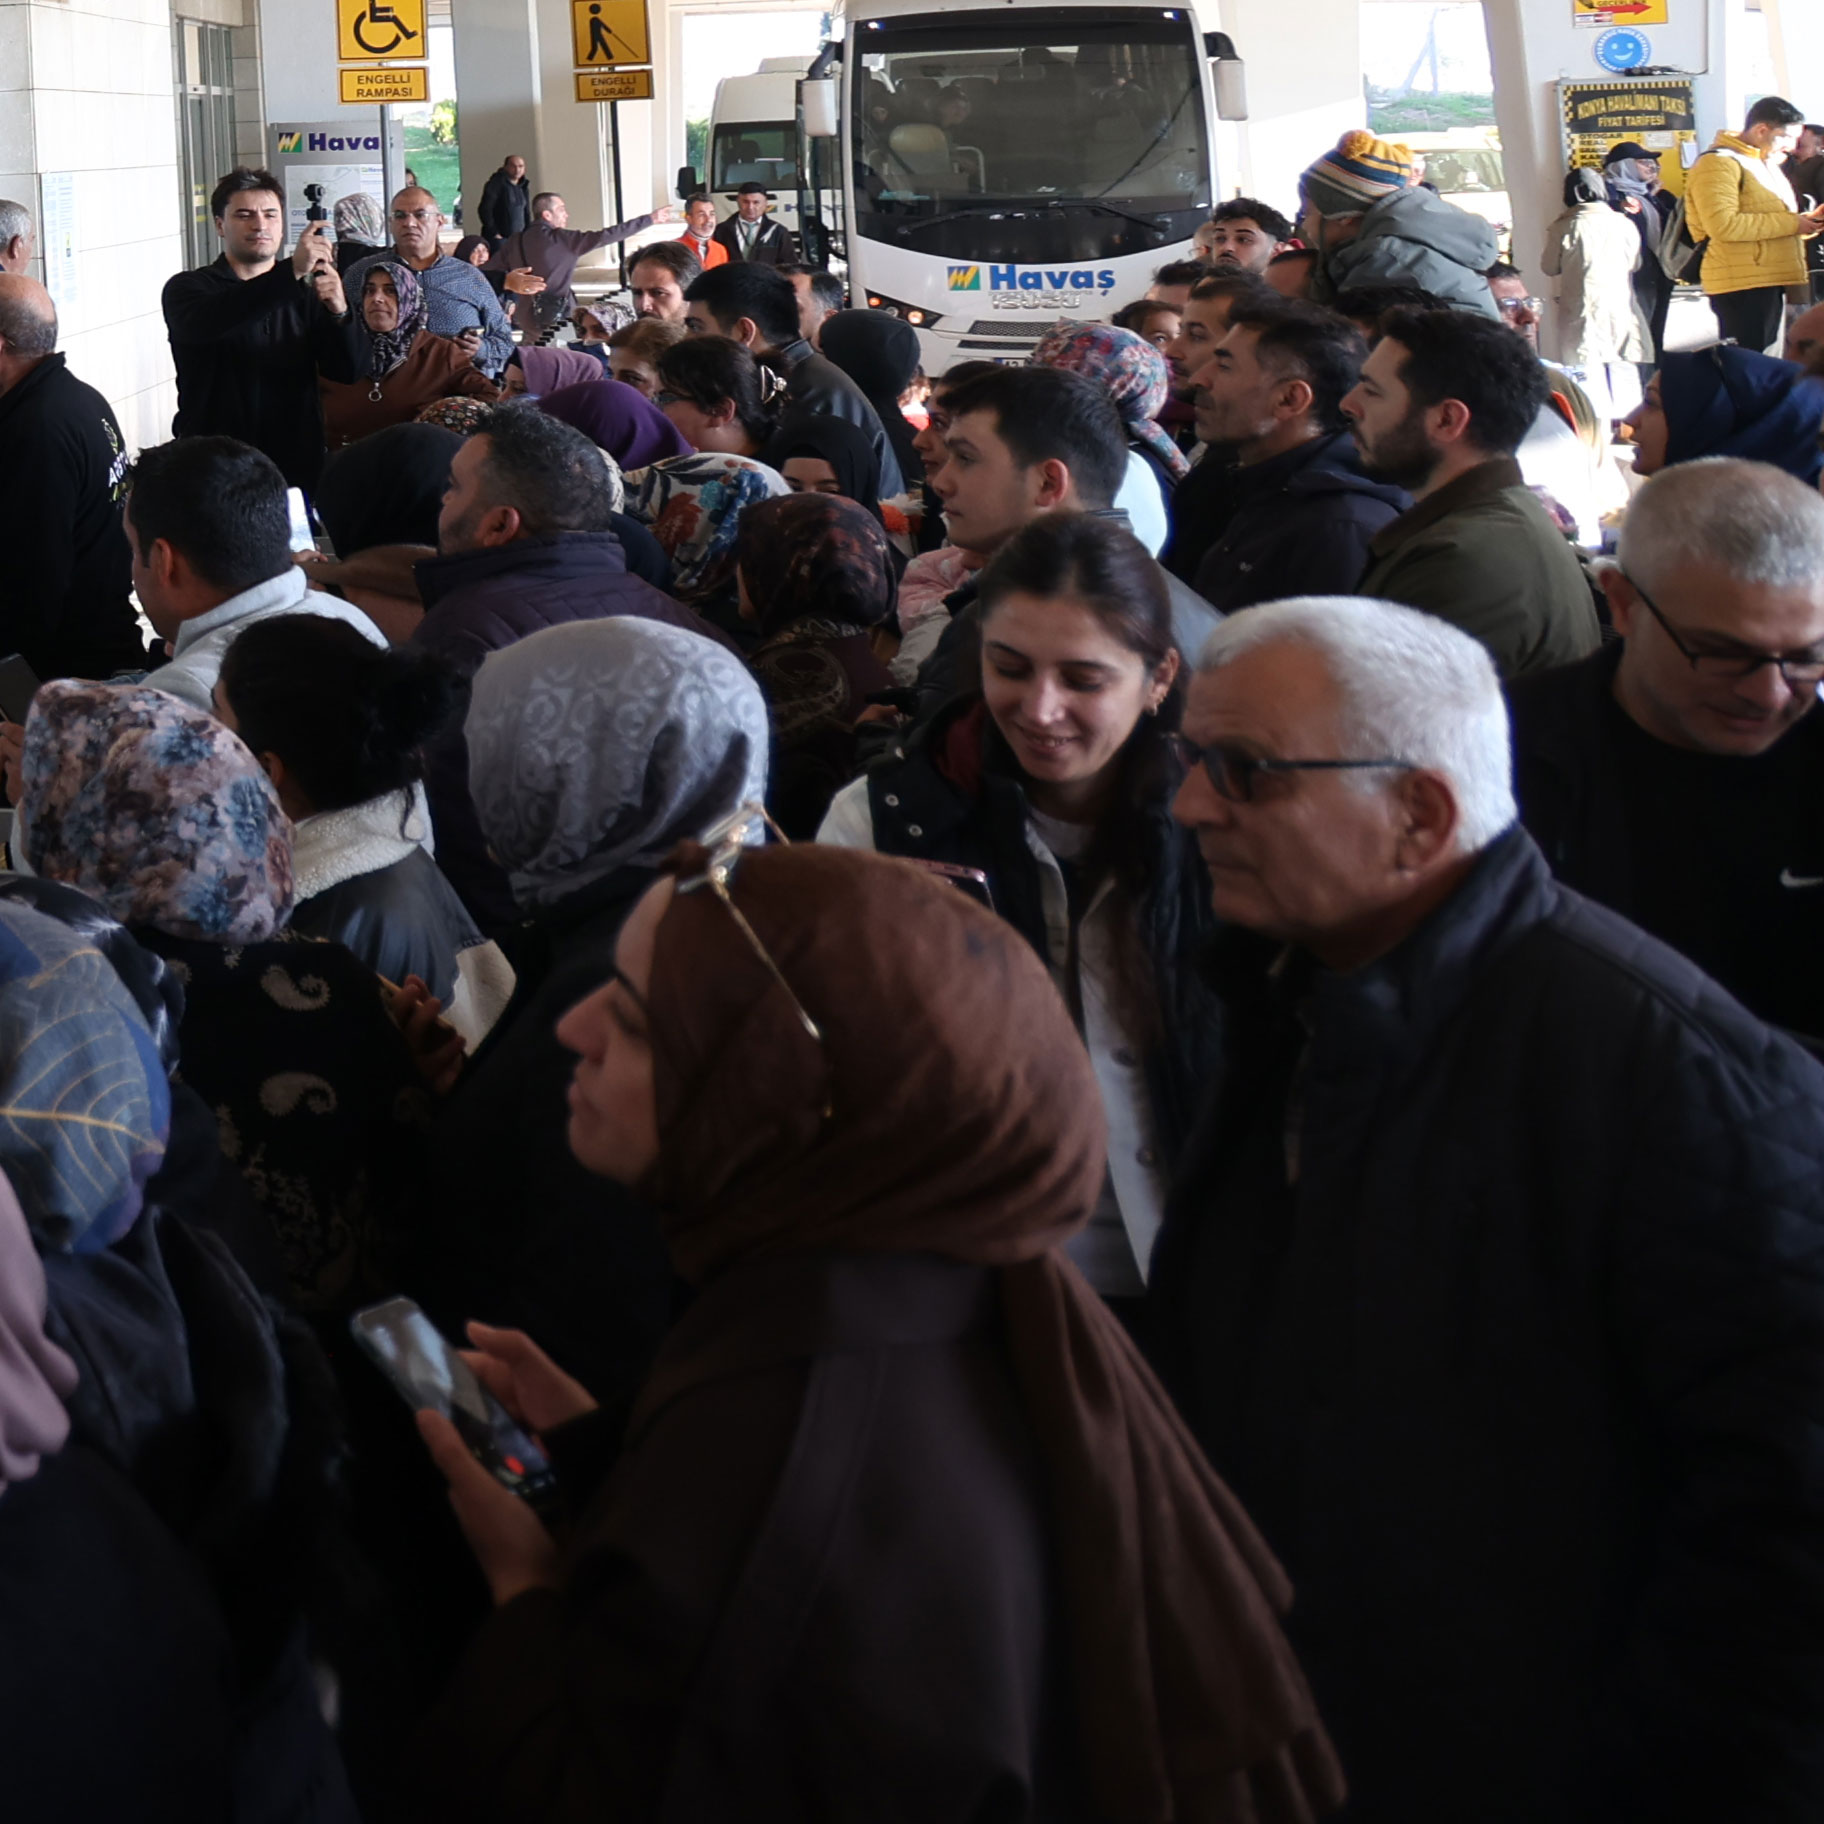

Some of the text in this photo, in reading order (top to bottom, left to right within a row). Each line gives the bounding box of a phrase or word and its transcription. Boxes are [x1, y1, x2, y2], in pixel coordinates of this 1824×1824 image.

[357, 72, 410, 84] ENGELLİ
[592, 76, 636, 85] ENGELLİ
[357, 88, 412, 97] RAMPASI
[594, 86, 635, 96] DURAĞI
[308, 133, 393, 151] Hava
[990, 264, 1115, 296] Havaş
[992, 293, 1080, 310] ISUZU
